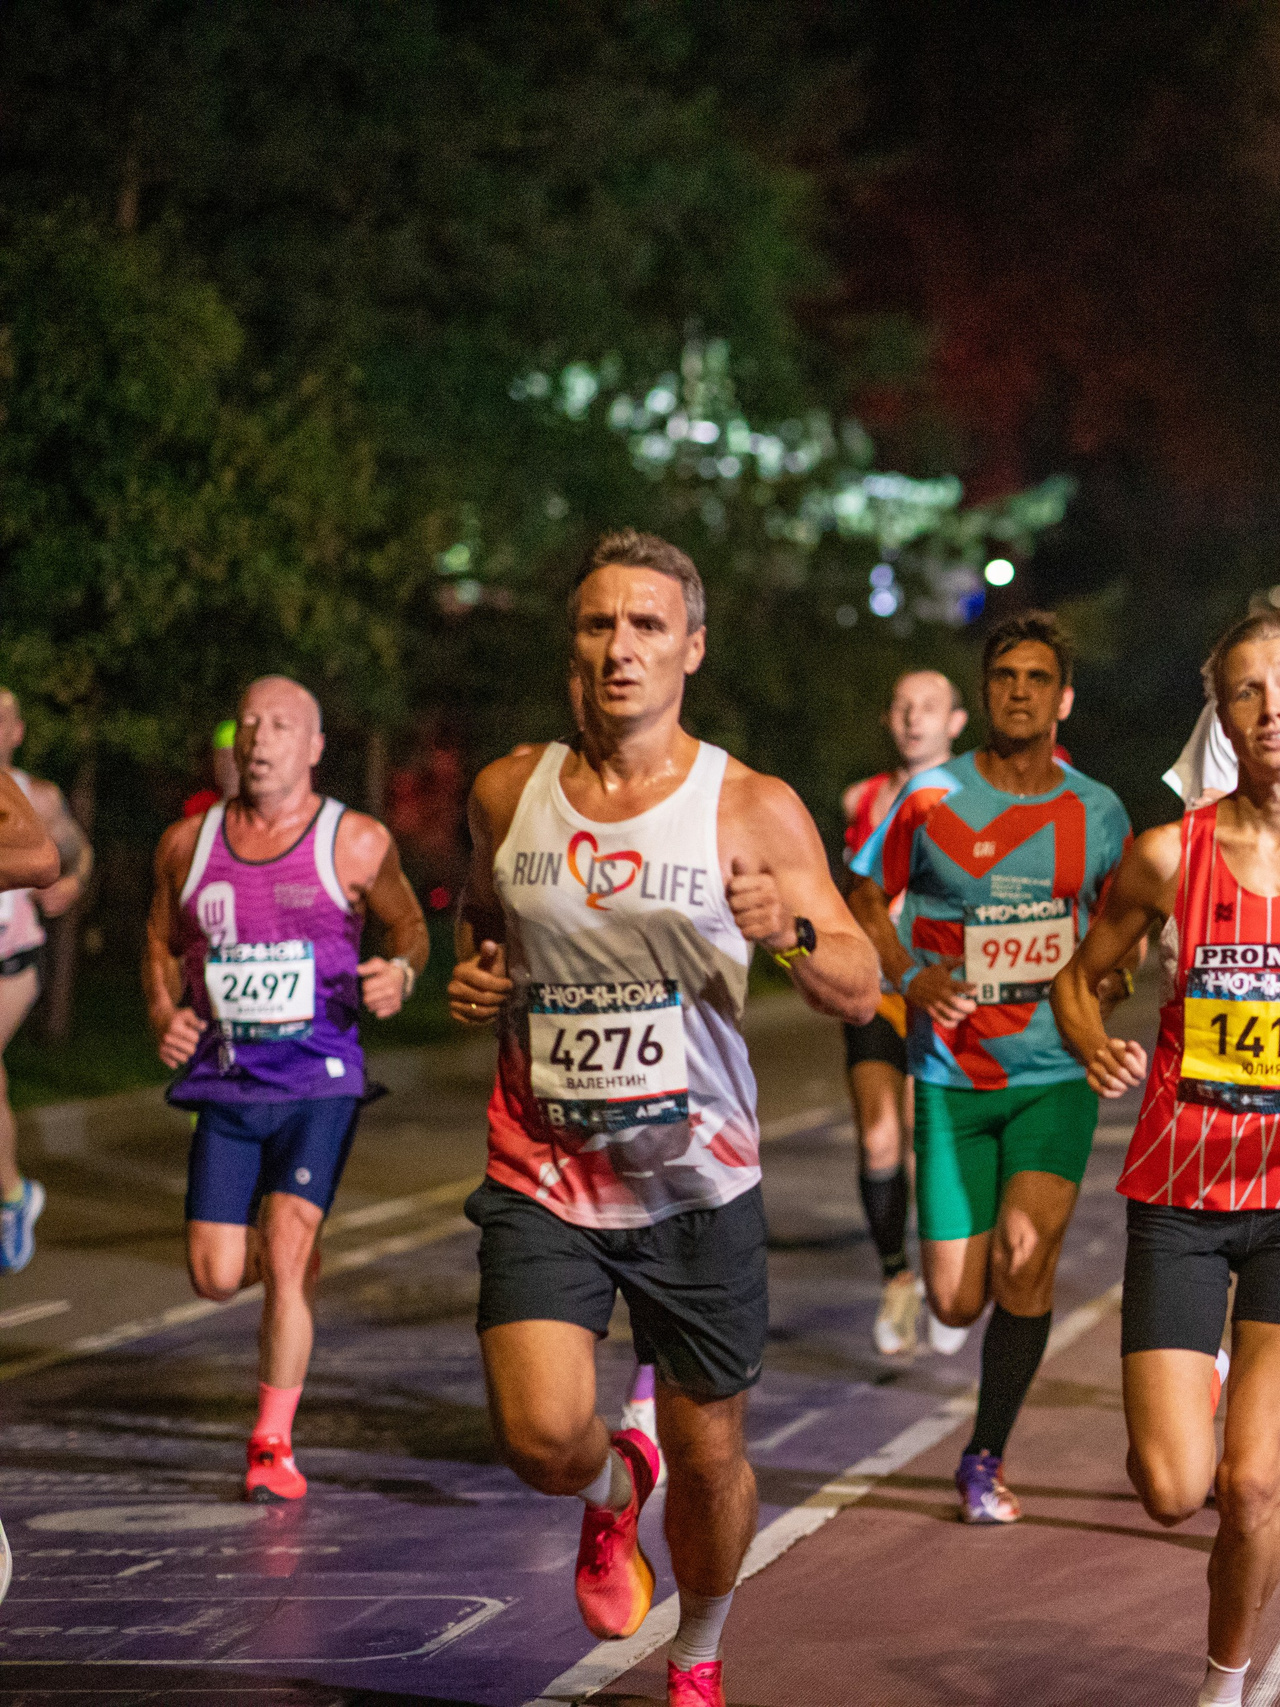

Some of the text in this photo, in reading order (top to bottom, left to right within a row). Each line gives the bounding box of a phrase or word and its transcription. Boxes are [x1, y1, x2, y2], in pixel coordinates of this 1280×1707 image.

[512, 852, 707, 907] RUN IS LIFE
[982, 933, 1061, 969] 9945
[1201, 947, 1259, 966] PRO
[222, 971, 299, 1001] 2497
[541, 982, 667, 1008] НОЧНОЙ
[551, 1024, 663, 1072] 4276
[566, 1074, 647, 1090] ВАЛЕНТИН
